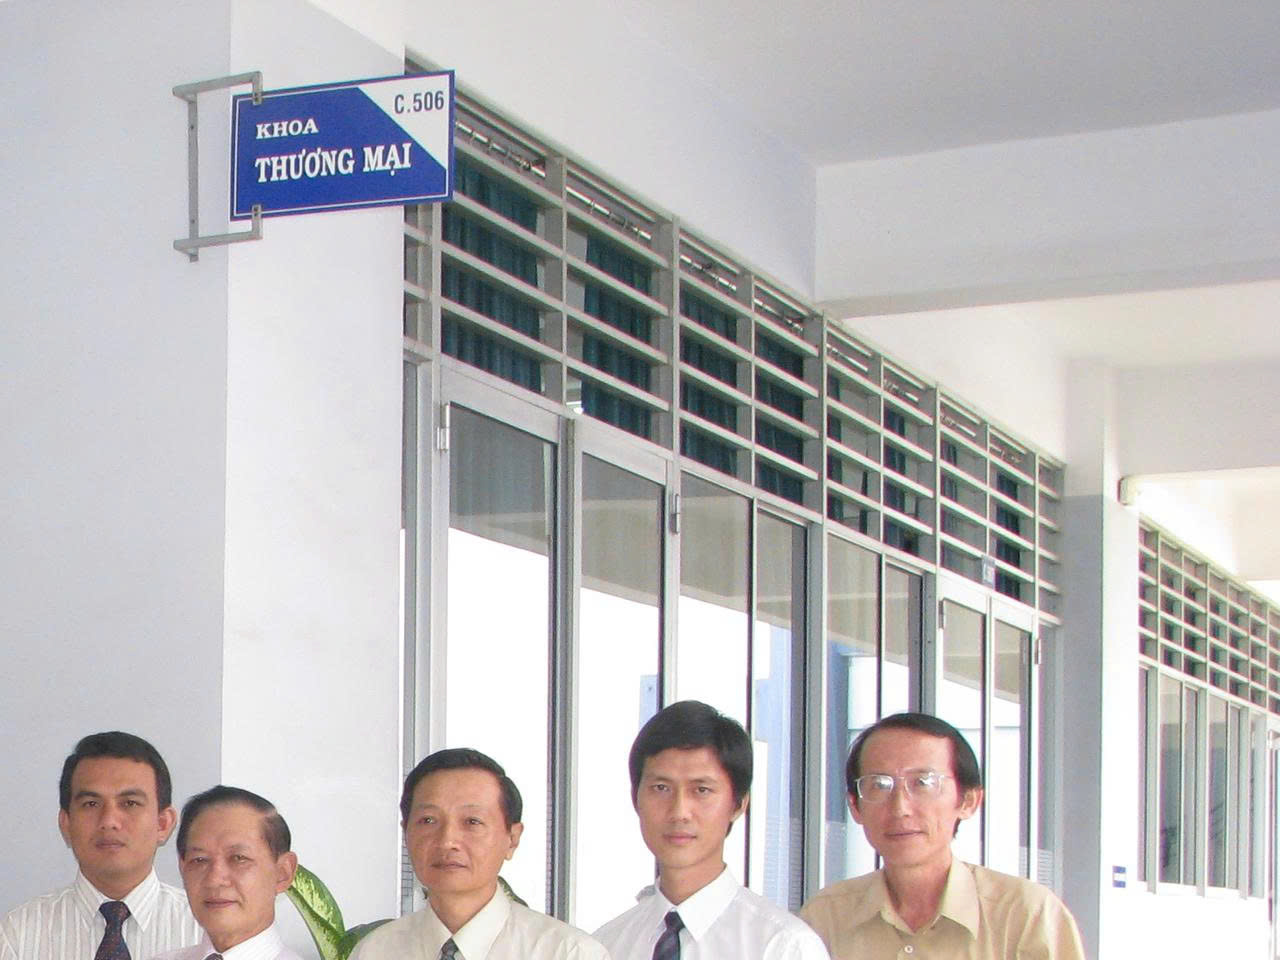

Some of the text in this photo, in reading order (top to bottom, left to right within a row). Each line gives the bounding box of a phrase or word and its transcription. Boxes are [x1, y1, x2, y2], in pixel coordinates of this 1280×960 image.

[394, 90, 444, 114] C.506
[255, 118, 319, 139] KHOA
[254, 143, 412, 183] THƯƠNG MẠI
